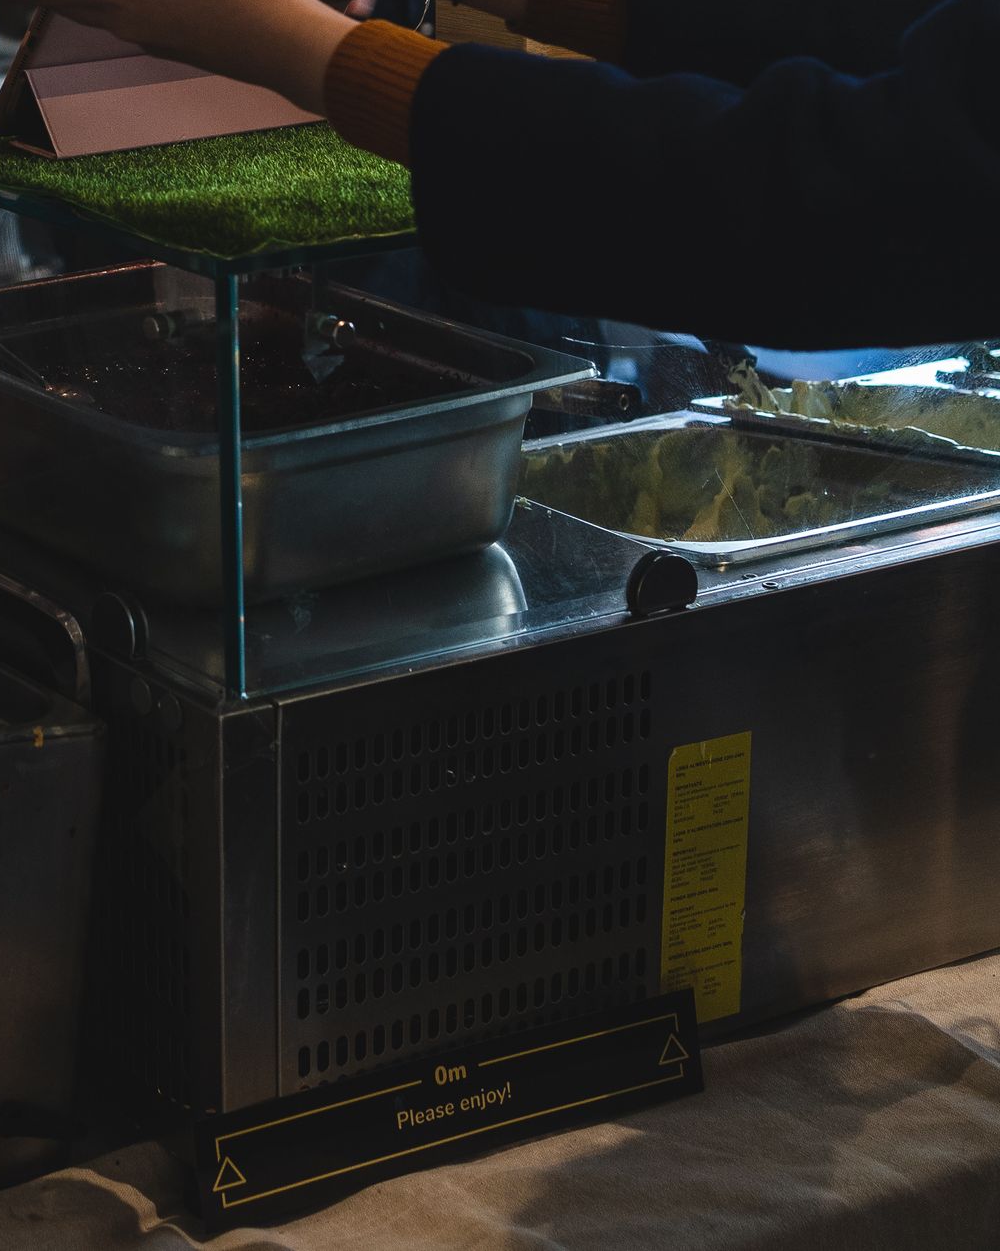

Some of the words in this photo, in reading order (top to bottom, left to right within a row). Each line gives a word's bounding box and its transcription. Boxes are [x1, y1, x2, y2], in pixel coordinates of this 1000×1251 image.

[434, 1064, 467, 1086] 0m
[397, 1102, 455, 1130] Please
[460, 1082, 512, 1110] enjoy!
